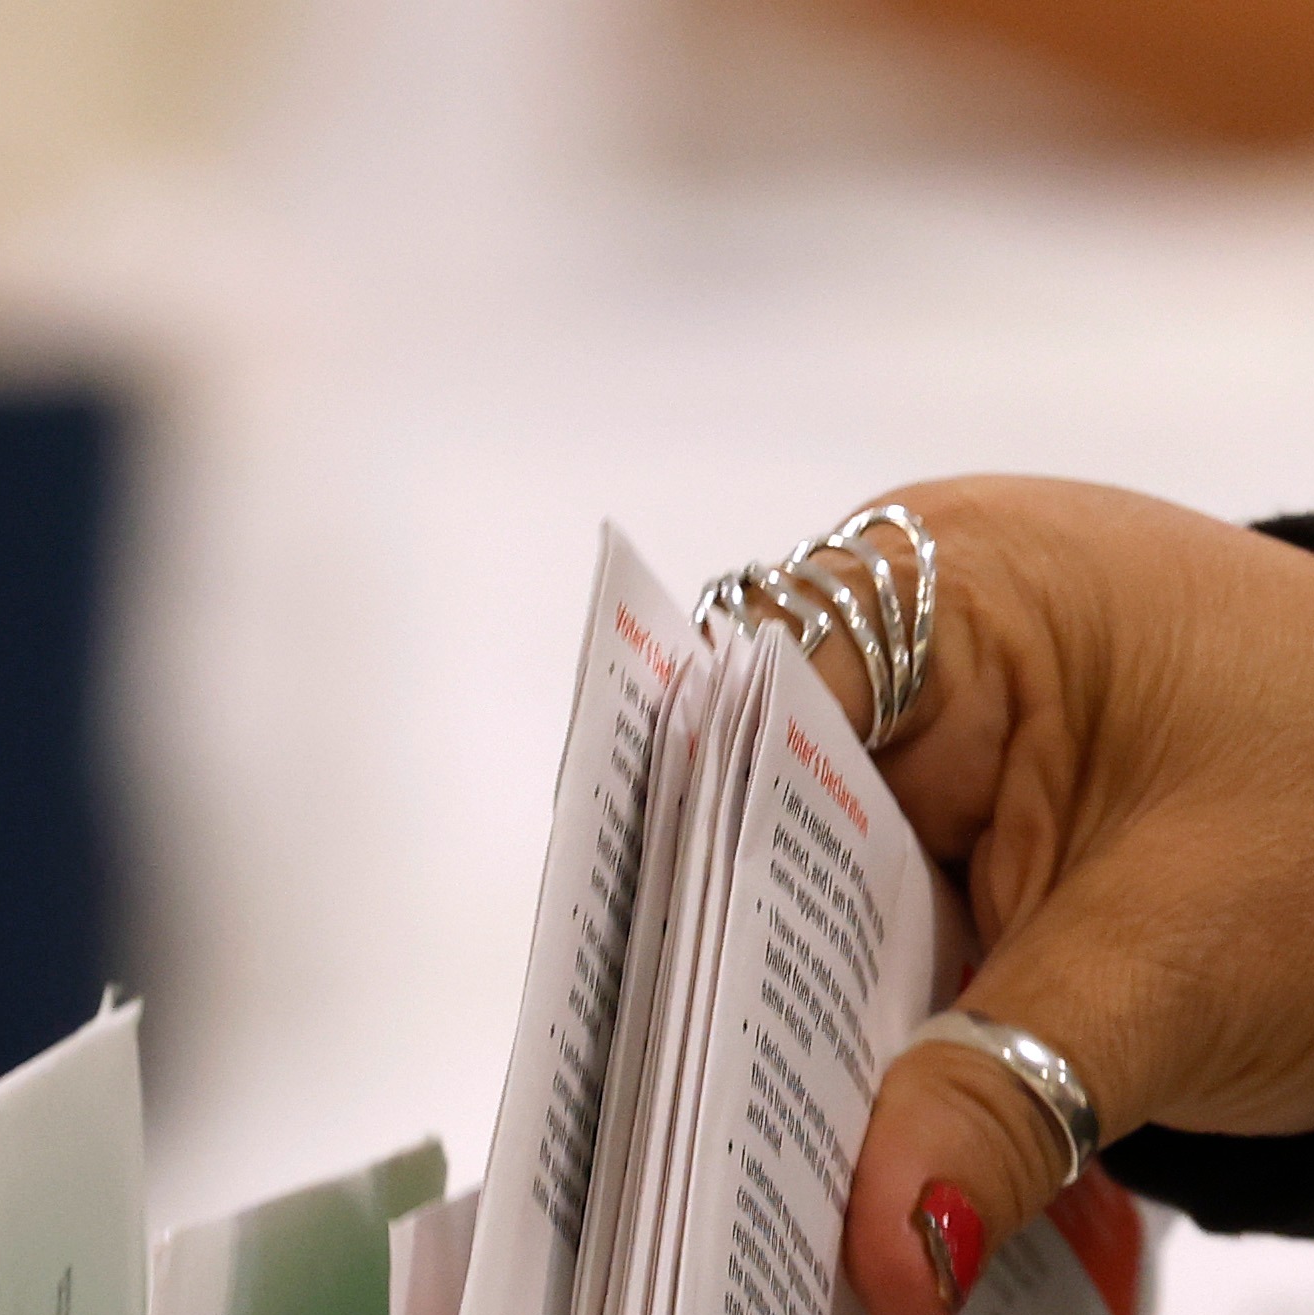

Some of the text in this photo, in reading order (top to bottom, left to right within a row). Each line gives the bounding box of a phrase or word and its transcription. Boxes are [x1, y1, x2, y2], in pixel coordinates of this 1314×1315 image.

[787, 715, 869, 839] Voter's Declaration
[808, 811, 842, 864] resident
